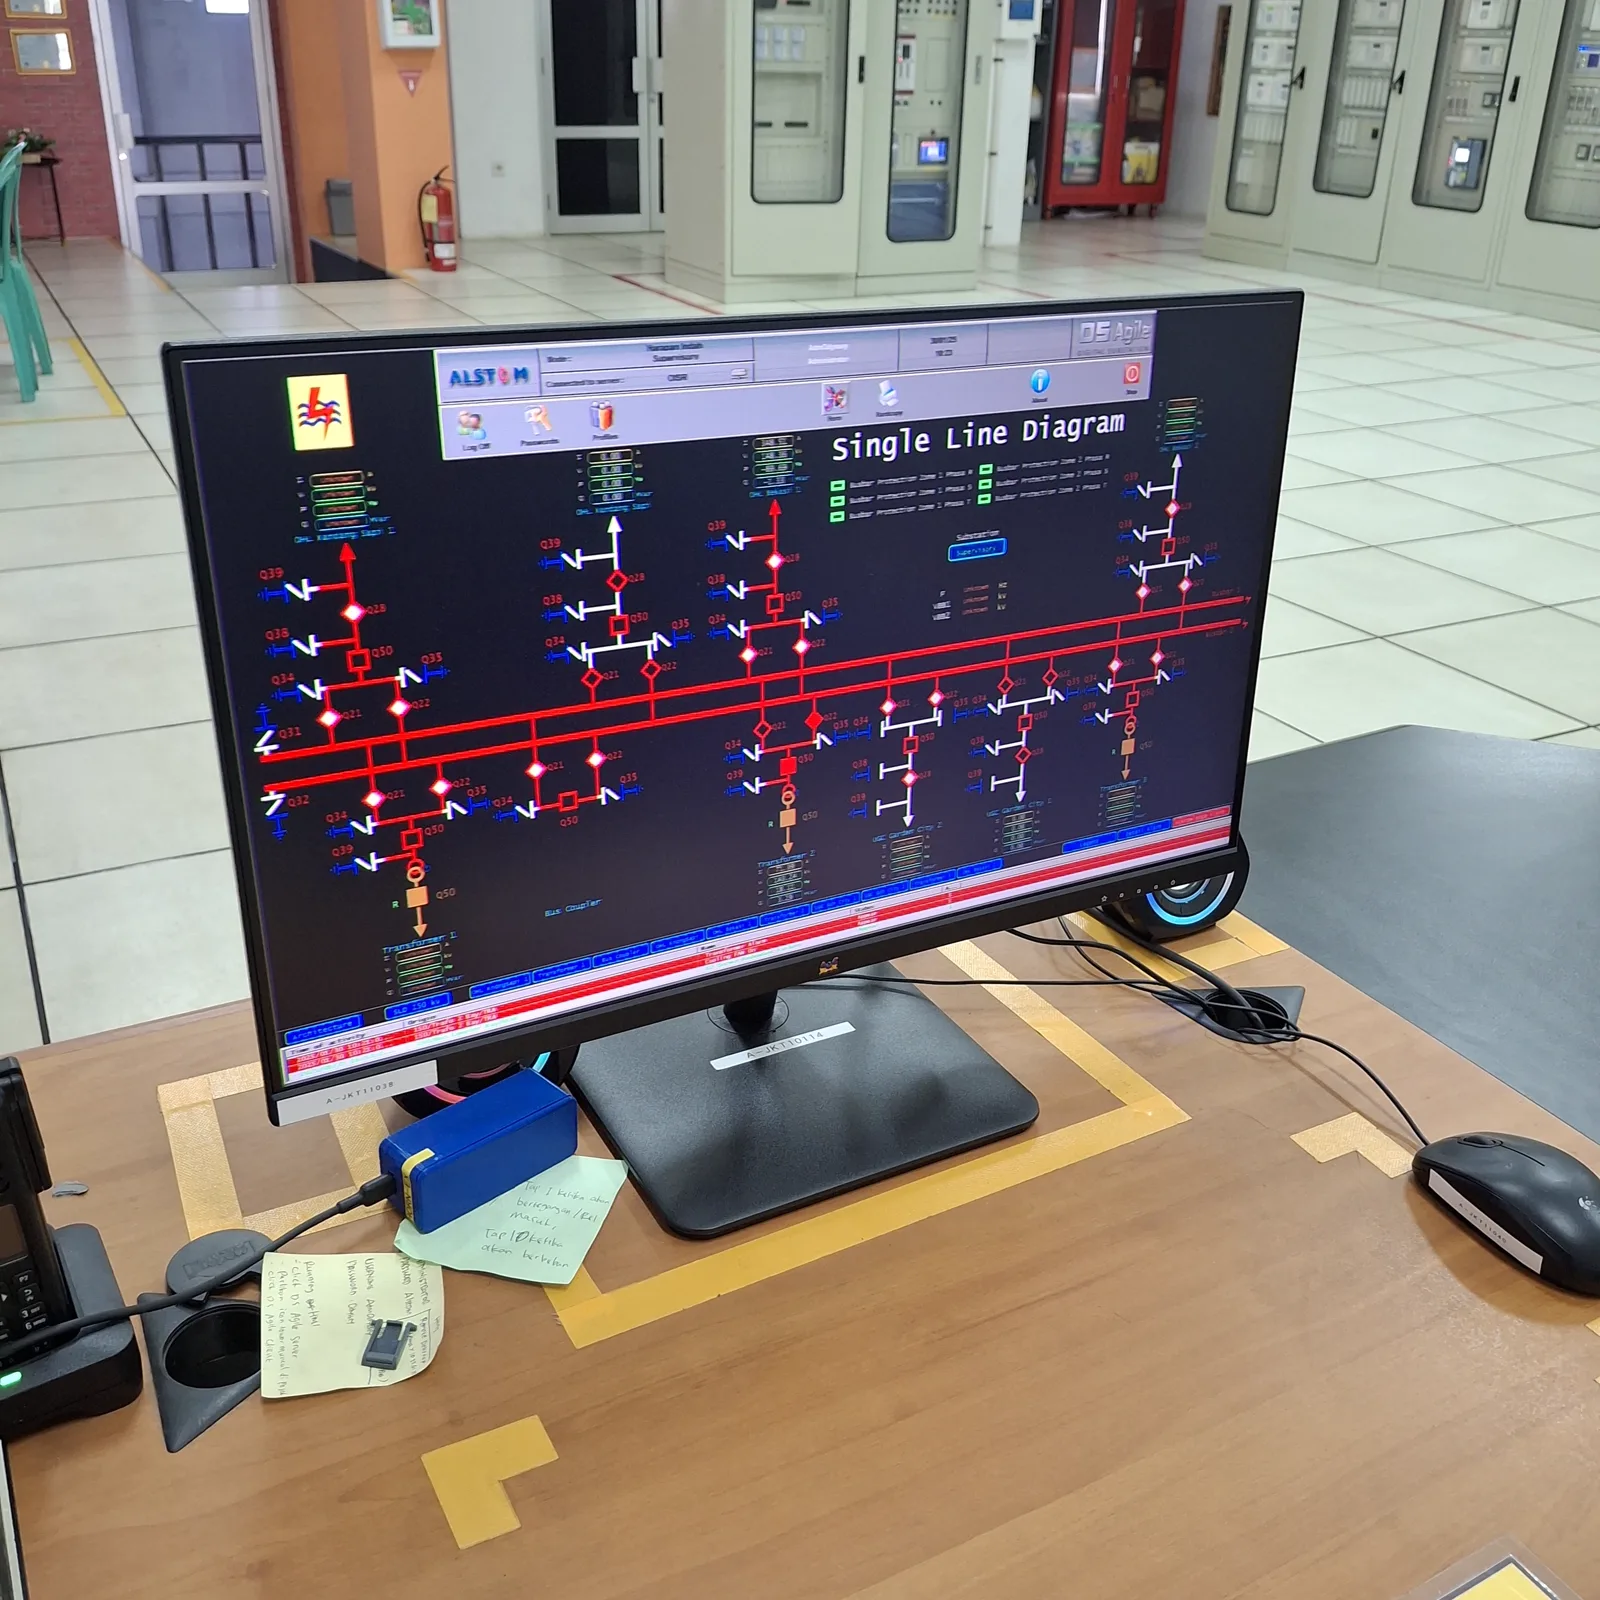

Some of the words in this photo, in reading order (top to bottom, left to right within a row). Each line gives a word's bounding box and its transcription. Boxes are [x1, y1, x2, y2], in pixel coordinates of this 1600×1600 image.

[1113, 320, 1152, 345] Agile
[450, 366, 529, 387] ALSTOM
[832, 427, 931, 462] Single
[946, 421, 1008, 451] Line
[1022, 412, 1126, 444] Diagram
[708, 520, 727, 532] Q39
[540, 538, 562, 550] Q39
[260, 567, 284, 580] Q39
[630, 612, 649, 623] Q50
[672, 618, 690, 630] Q35
[545, 636, 565, 648] Q34
[372, 646, 394, 659] Q50
[421, 652, 443, 664] Q35
[271, 673, 295, 685] Q34
[603, 670, 620, 680] Q21
[412, 698, 431, 710] Q22
[343, 709, 362, 720] Q21
[279, 727, 302, 739] Q31
[607, 750, 624, 762] Q22
[548, 761, 565, 771] Q21
[453, 778, 471, 789] Q22
[620, 772, 638, 784] Q35
[387, 789, 405, 800] Q21
[467, 785, 488, 797] Q35
[288, 794, 310, 808] Q32
[493, 795, 513, 808] Q34
[326, 812, 348, 824] Q34
[560, 816, 579, 828] Q50
[424, 824, 445, 836] Q50
[332, 844, 355, 857] Q39
[436, 888, 456, 900] Q50
[392, 900, 400, 909] R
[545, 908, 563, 918] Bus
[565, 899, 603, 913] Coupler
[382, 934, 447, 954] Transformer
[292, 1021, 353, 1041] Architecture
[746, 1031, 824, 1059] A-JKT10114
[326, 1081, 394, 1105] A-JKT11038
[22, 1310, 29, 1318] 3
[26, 1322, 32, 1330] 6
